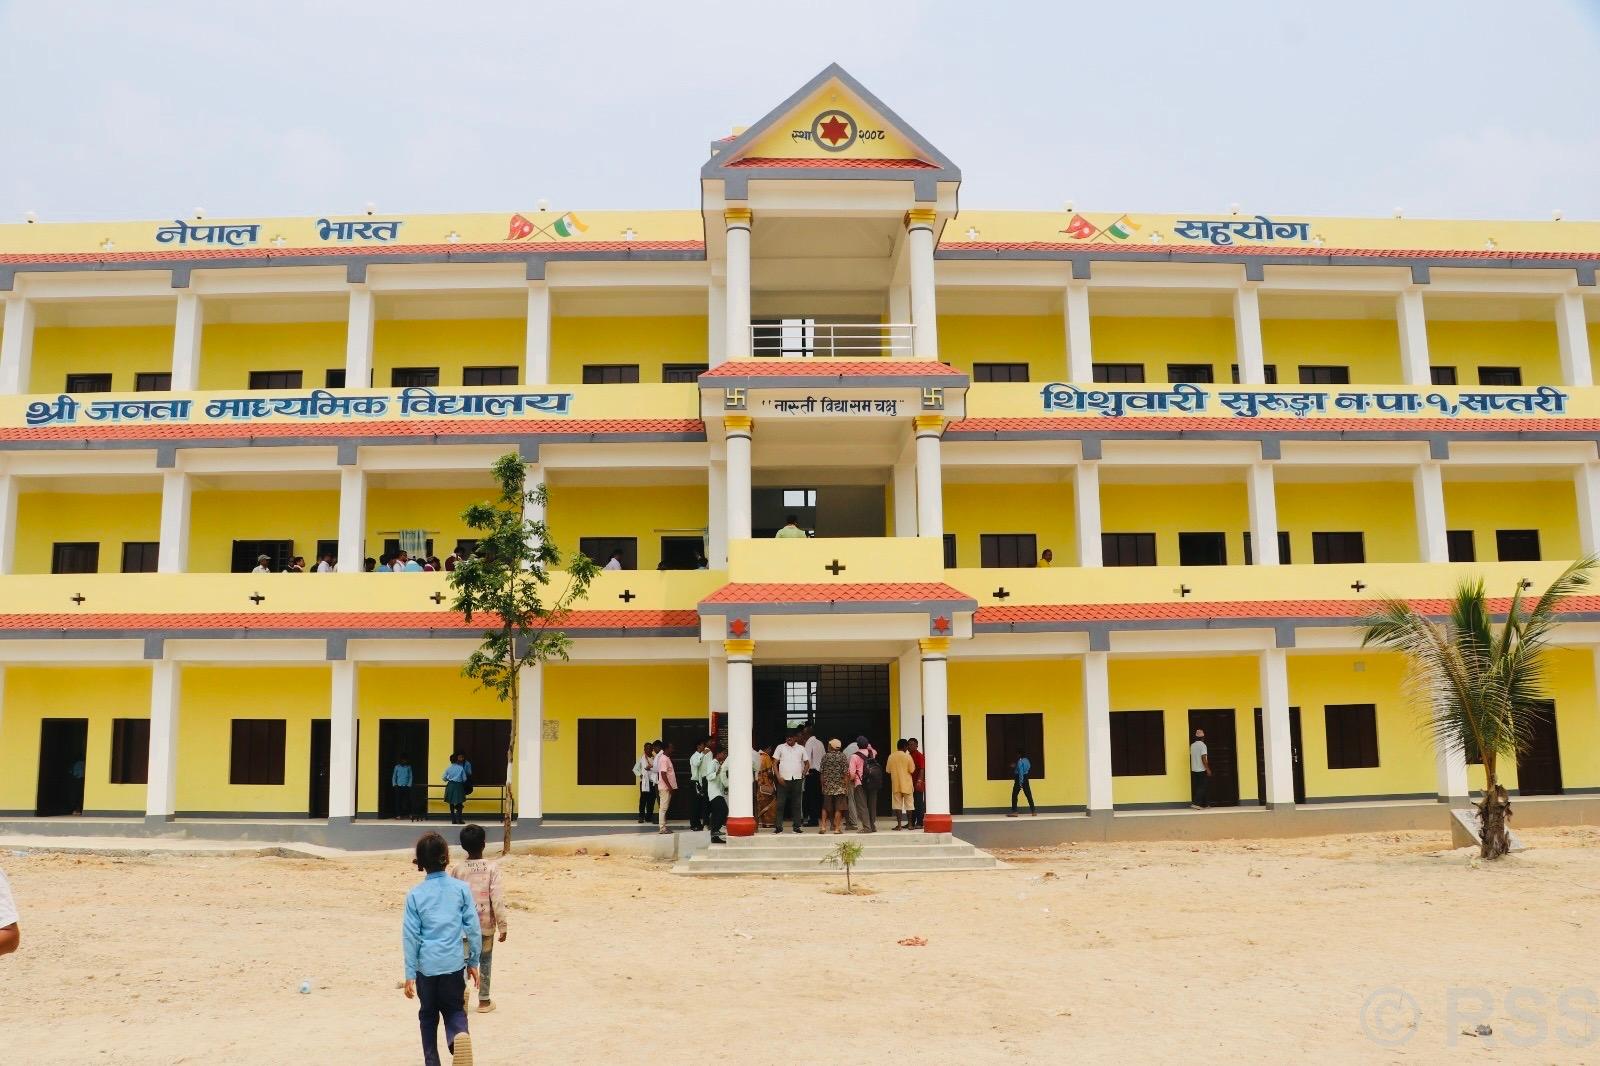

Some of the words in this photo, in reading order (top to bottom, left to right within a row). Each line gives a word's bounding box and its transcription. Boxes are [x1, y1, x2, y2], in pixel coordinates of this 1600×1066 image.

[155, 219, 261, 246] नेपाल
[316, 218, 403, 241] भारत
[1173, 215, 1310, 246] सहयोग
[25, 394, 79, 425] श्री
[84, 399, 192, 420] जनता
[204, 389, 389, 419] माध्यमिक
[397, 387, 572, 416] विद्यालय
[1040, 382, 1209, 417] शिशुवारी
